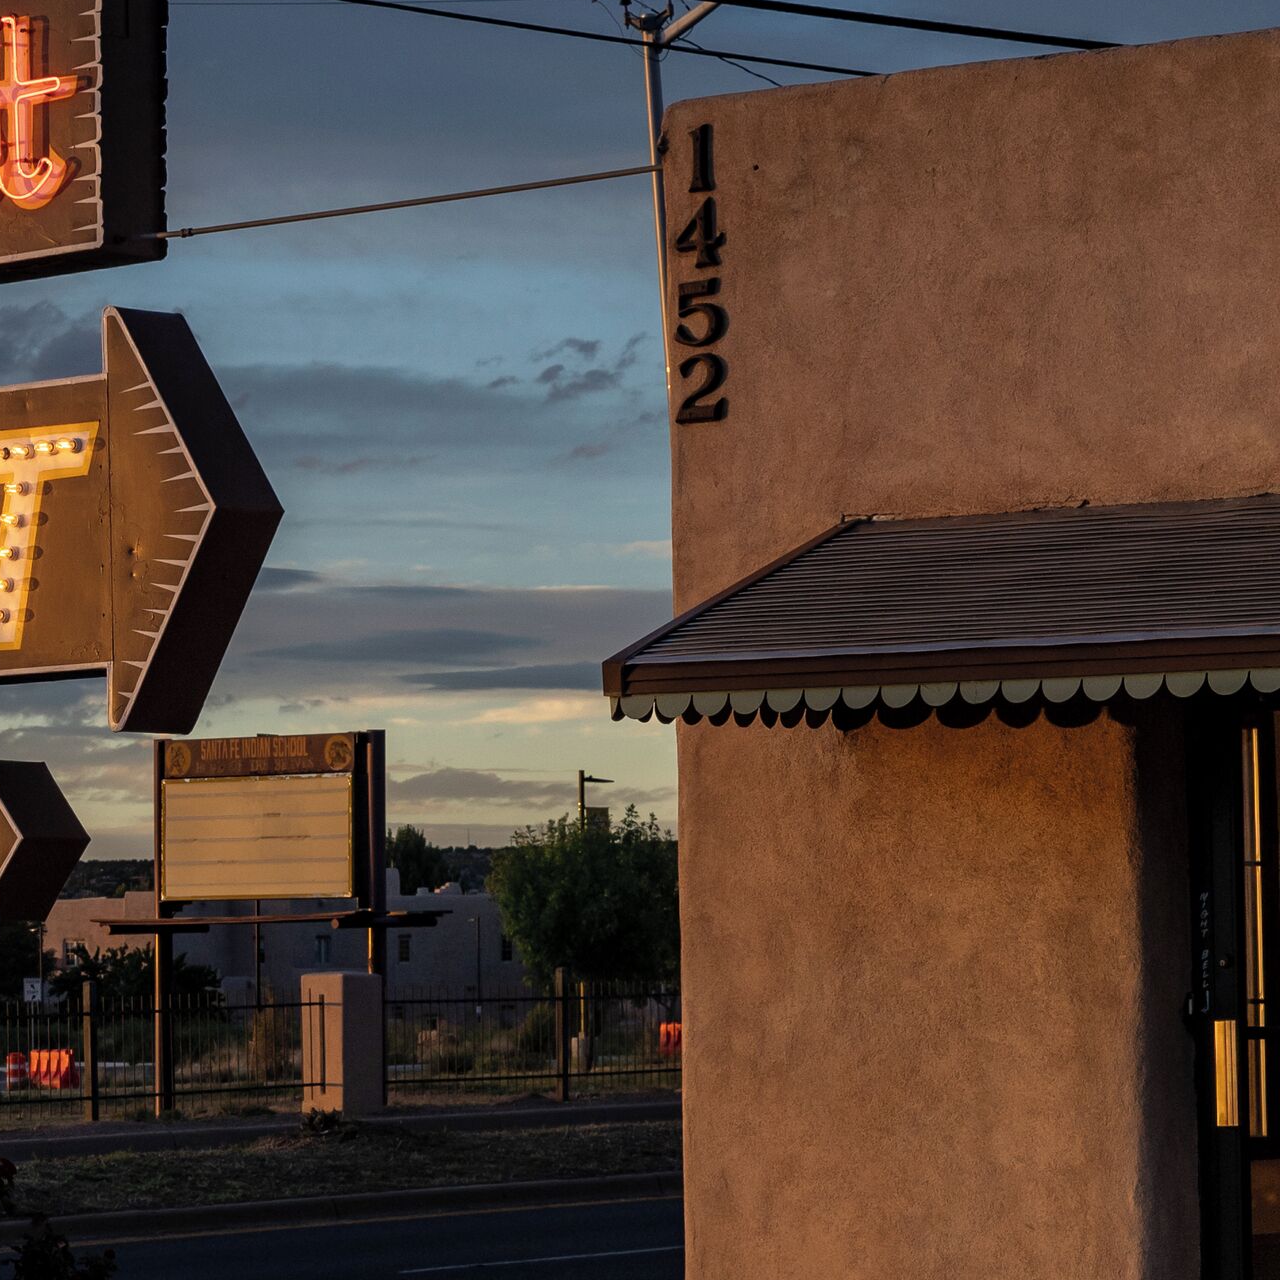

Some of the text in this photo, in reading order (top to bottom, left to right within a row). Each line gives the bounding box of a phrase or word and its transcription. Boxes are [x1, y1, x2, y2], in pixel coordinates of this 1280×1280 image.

[675, 123, 730, 424] 1452
[200, 736, 309, 761] SANTA FE INDIAN SCHOOL
[1201, 949, 1209, 988] BELL
